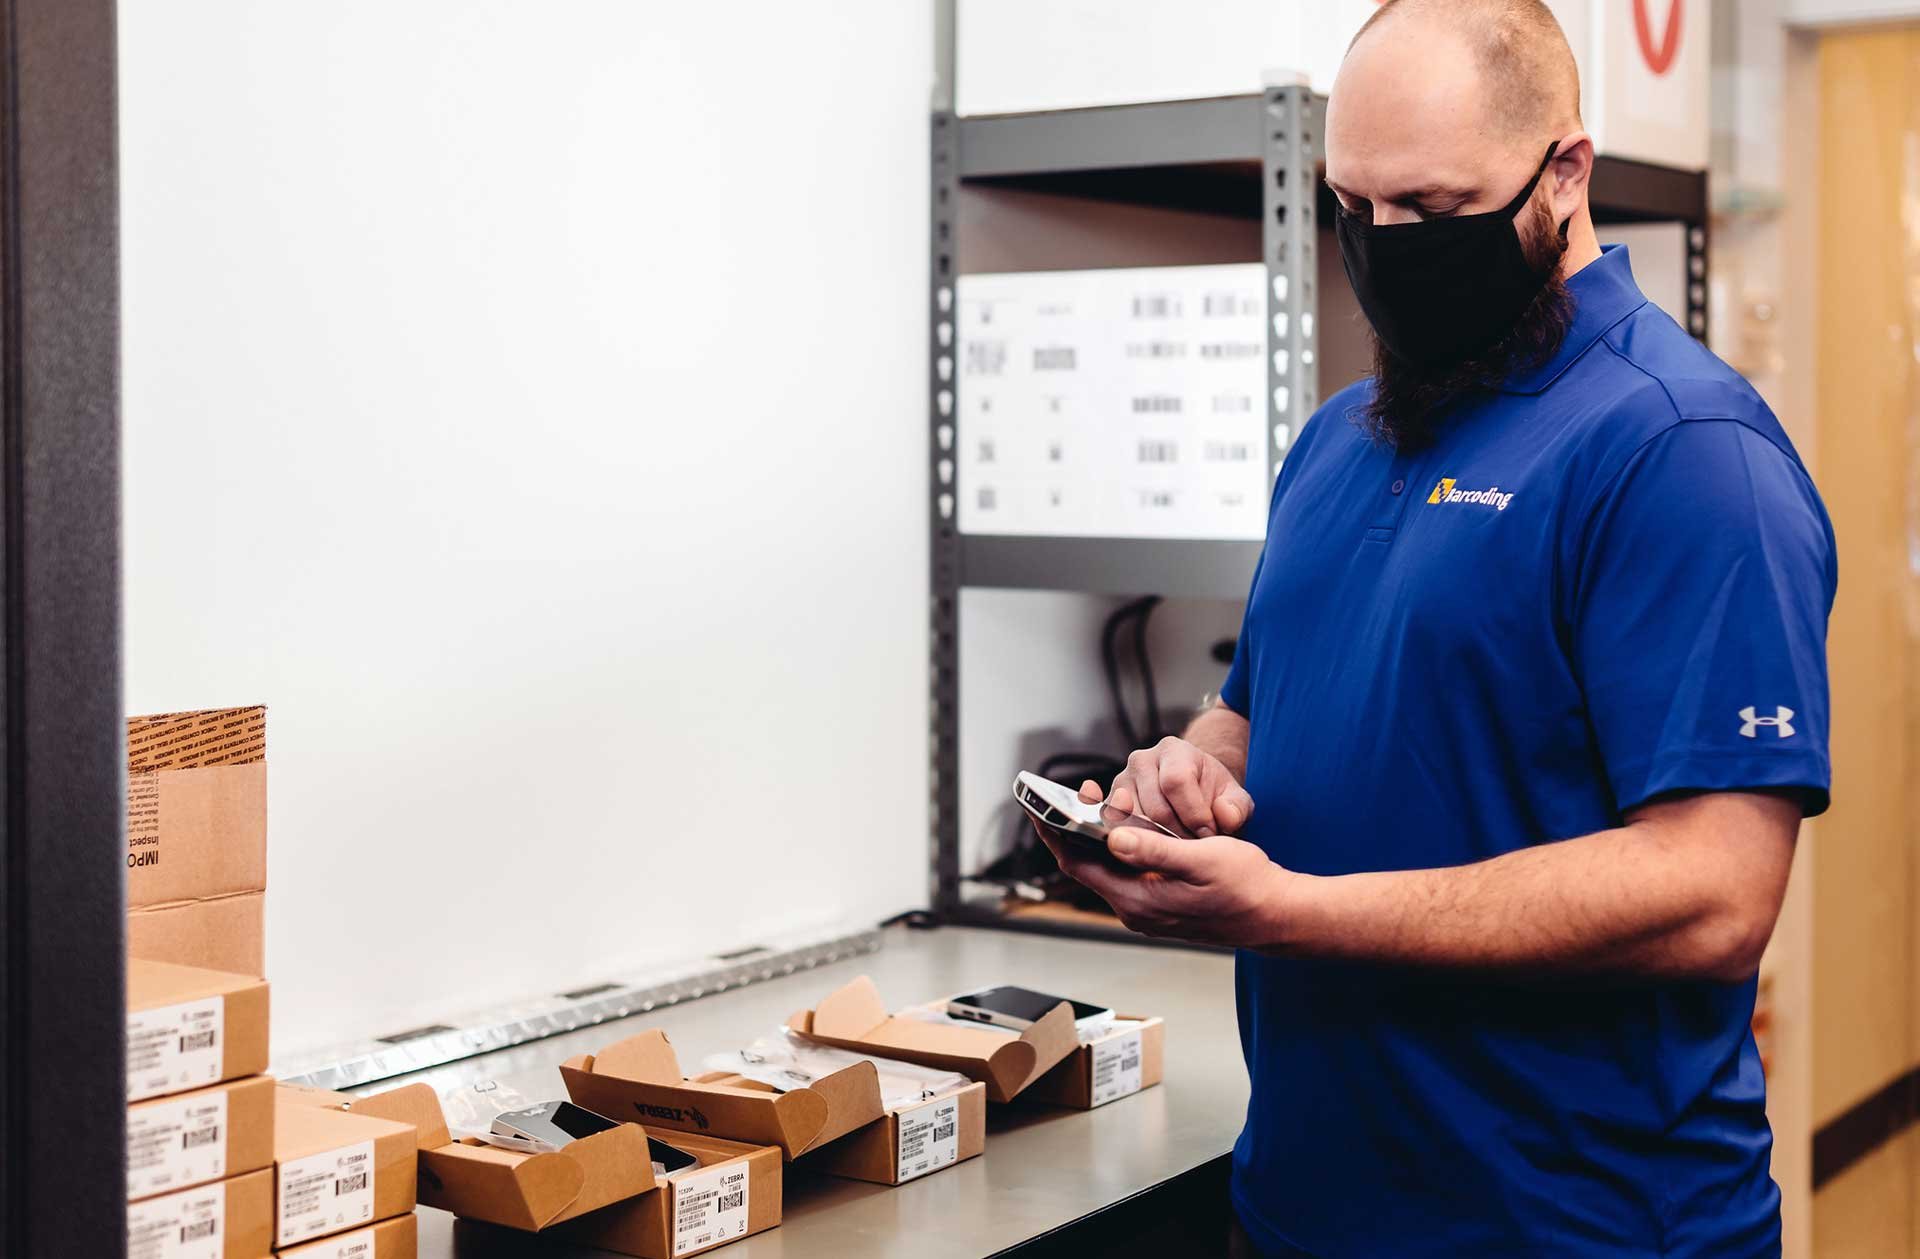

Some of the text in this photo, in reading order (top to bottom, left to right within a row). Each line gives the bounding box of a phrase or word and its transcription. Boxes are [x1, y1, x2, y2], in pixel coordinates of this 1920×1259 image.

[176, 722, 192, 731] CHECK
[201, 726, 217, 735] CHECK
[150, 728, 175, 740] CONTENTS
[175, 731, 200, 743] CONTENTS
[226, 729, 241, 737] CHECK
[199, 734, 225, 746] CONTENTS
[224, 738, 249, 749] CONTENTS
[129, 835, 158, 847] Inspect
[127, 850, 158, 868] IMPO
[728, 1173, 745, 1184] ZEBRA
